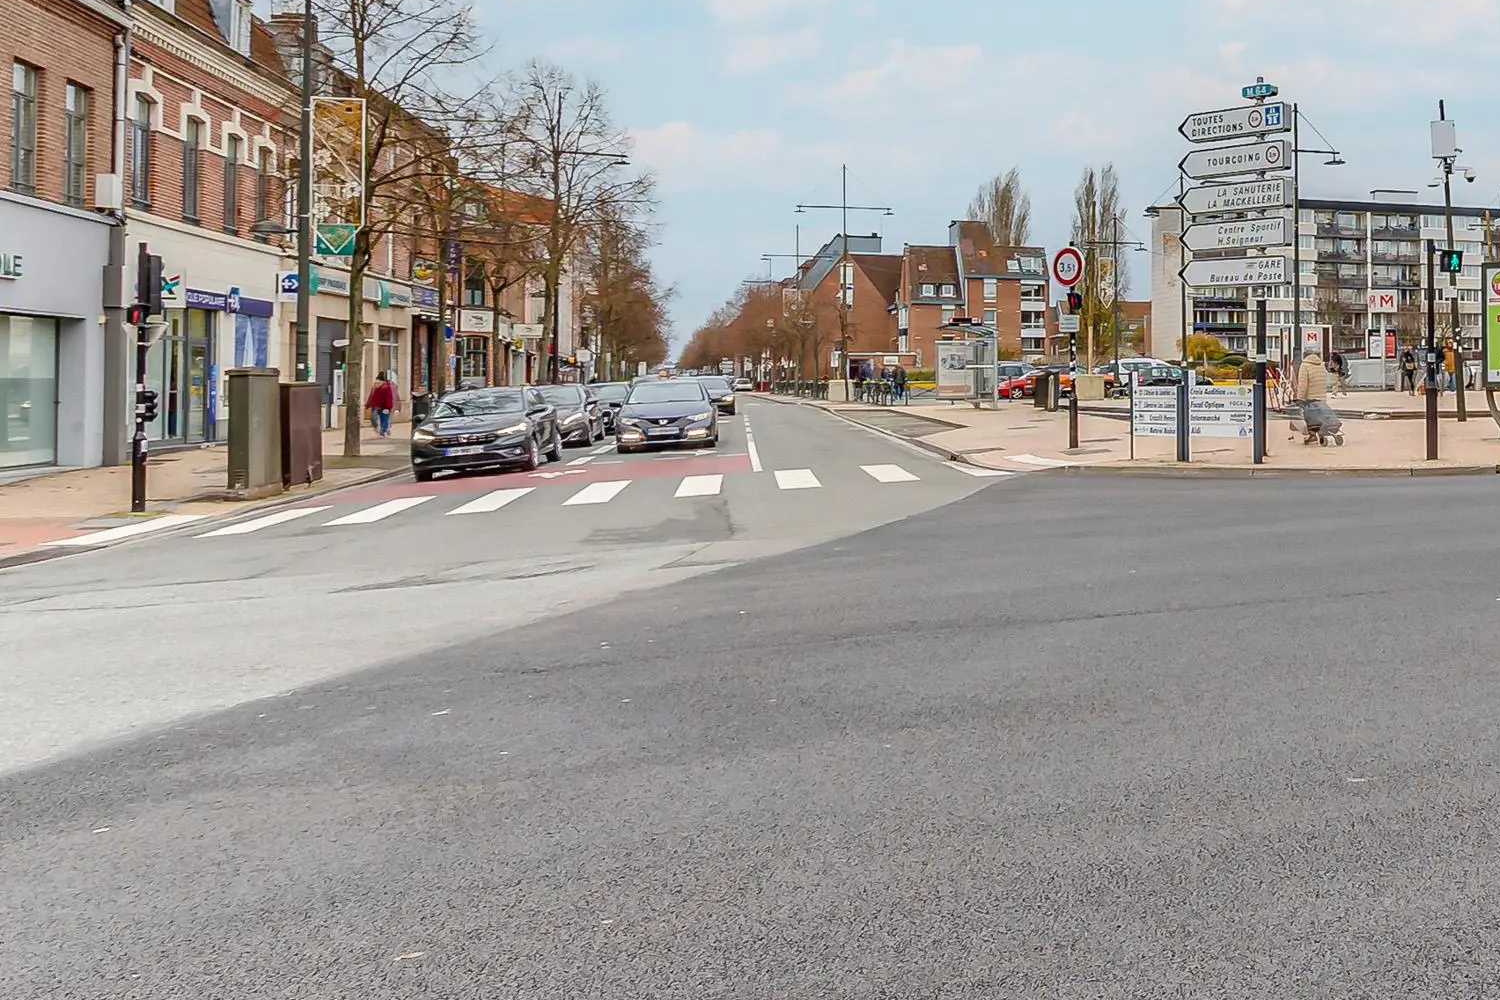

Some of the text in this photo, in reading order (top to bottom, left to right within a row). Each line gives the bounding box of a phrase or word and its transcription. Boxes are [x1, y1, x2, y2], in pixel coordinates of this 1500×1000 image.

[1192, 115, 1224, 126] TOUTES
[1192, 123, 1243, 137] DIRECTIONS
[1207, 153, 1260, 167] TOURCOING
[1217, 183, 1281, 197] LA SAHUTERIE
[1207, 194, 1281, 209] LA MACKELLERIE
[1218, 221, 1281, 234] Centre Sportif
[1258, 260, 1281, 269] GARE
[1210, 272, 1282, 282] Bureau de Poste
[1204, 401, 1225, 410] Optique
